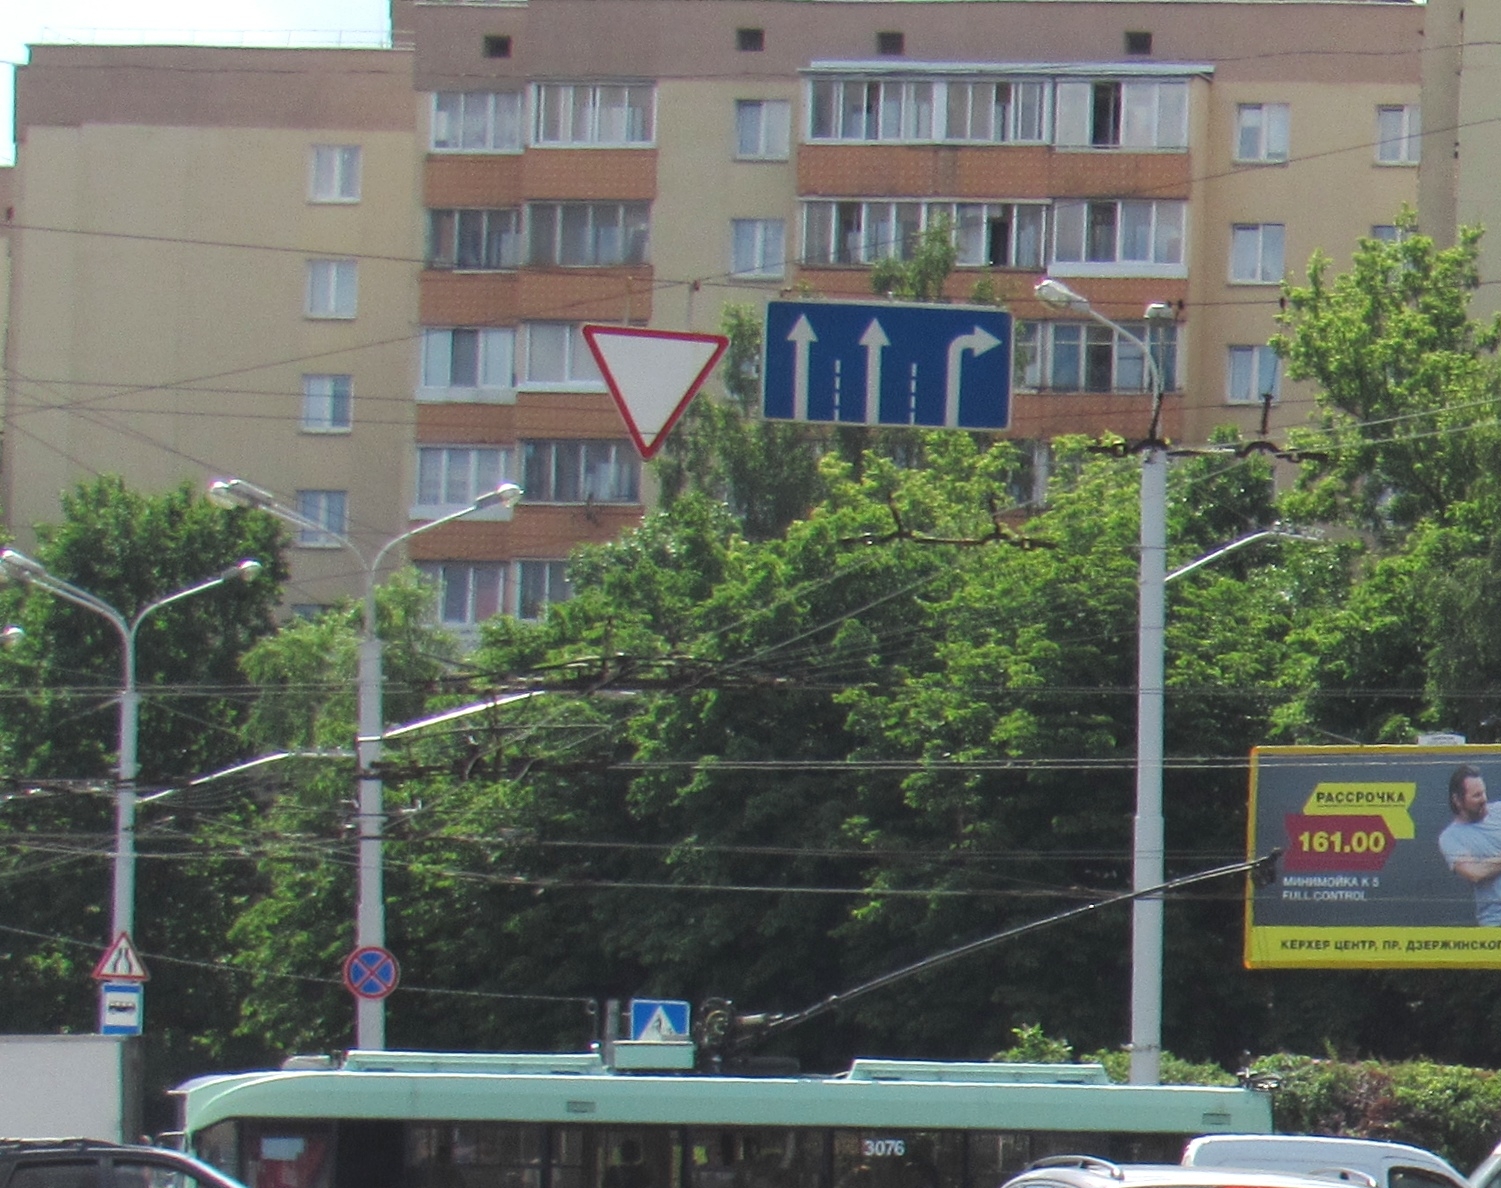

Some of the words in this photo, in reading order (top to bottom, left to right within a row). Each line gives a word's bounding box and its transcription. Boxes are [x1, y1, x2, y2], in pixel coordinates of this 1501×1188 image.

[1316, 790, 1406, 804] РАССРОЧКА
[1299, 831, 1385, 853] 161.00
[1283, 875, 1359, 888] МИНИМОЙКА
[1282, 890, 1309, 901] FULL
[1315, 890, 1367, 901] CONTROL
[1281, 939, 1331, 951] КЕРХЕР
[1334, 940, 1378, 952] ЦЕНТР,
[1382, 940, 1401, 951] ПР.
[864, 1139, 906, 1156] 3076
